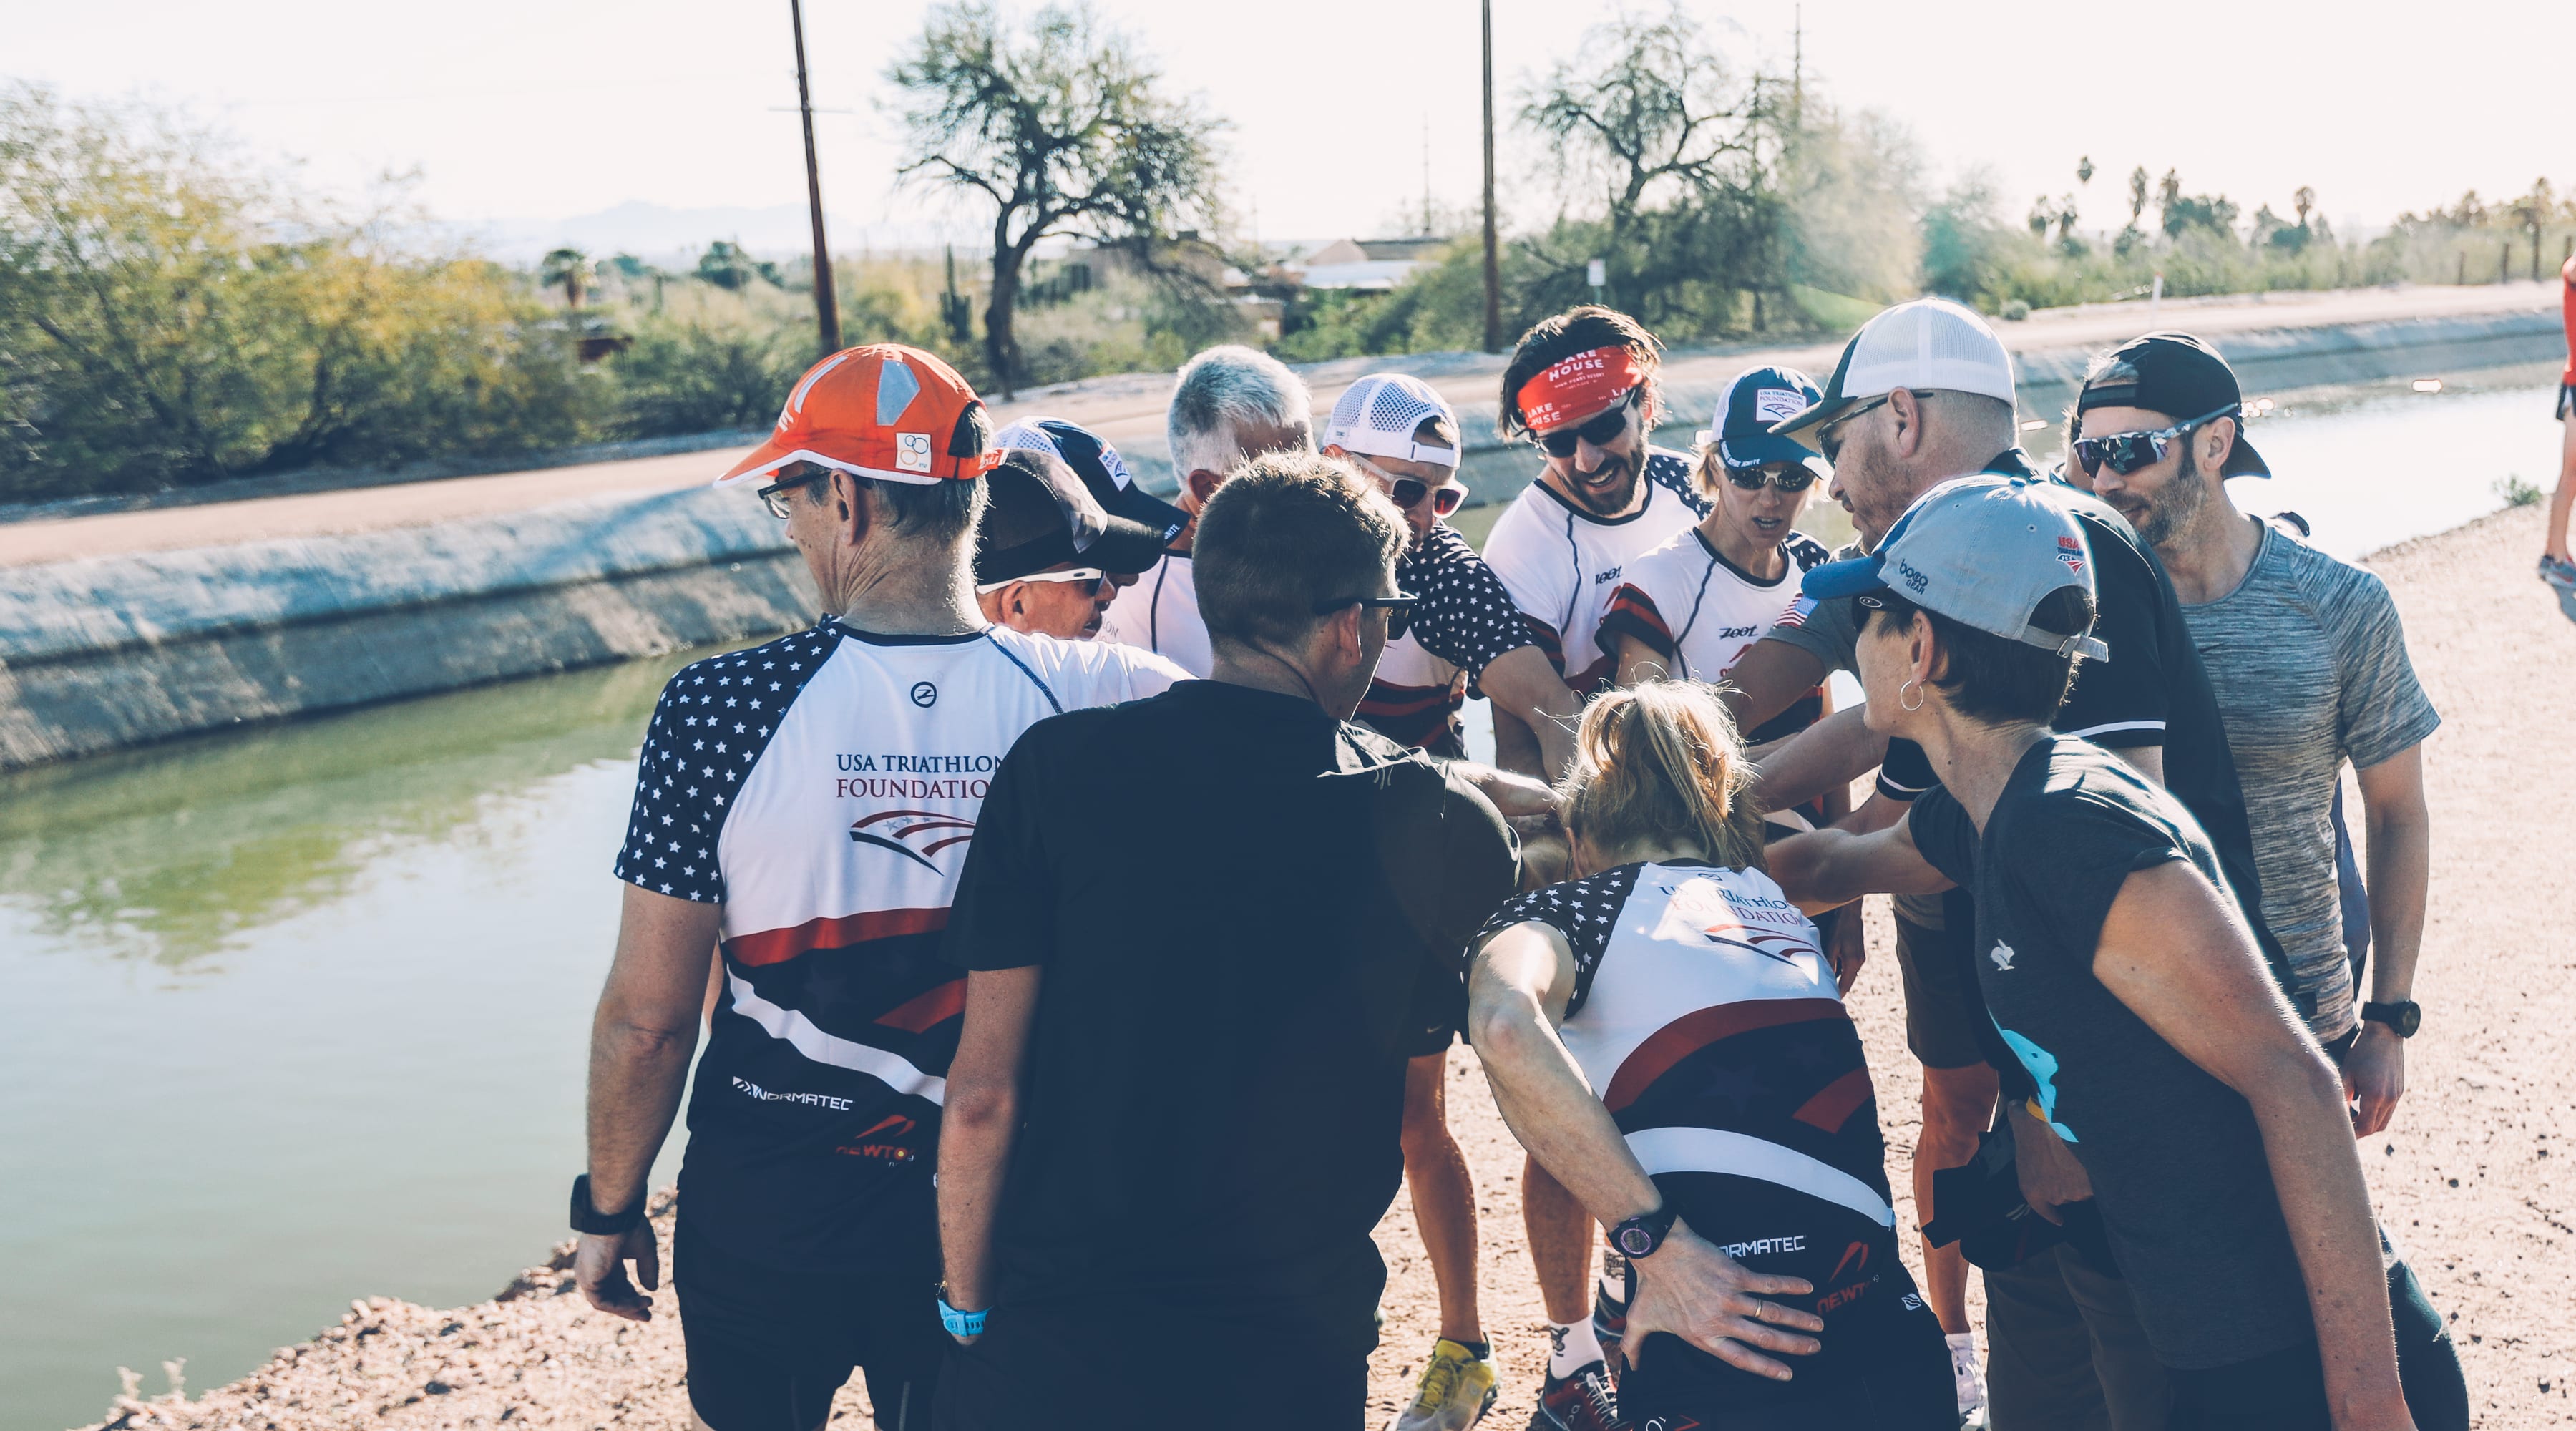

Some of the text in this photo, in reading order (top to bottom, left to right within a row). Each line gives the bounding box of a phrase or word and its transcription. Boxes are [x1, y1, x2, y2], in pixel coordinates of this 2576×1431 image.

[1548, 359, 1604, 382] HOUSE
[1527, 402, 1553, 419] LAKE
[2057, 536, 2079, 550] USA
[836, 753, 877, 772] USA
[836, 778, 990, 799] FOUNDATIO
[751, 1083, 854, 1111] NORMATEC
[1719, 1235, 1805, 1259] ORMATEC
